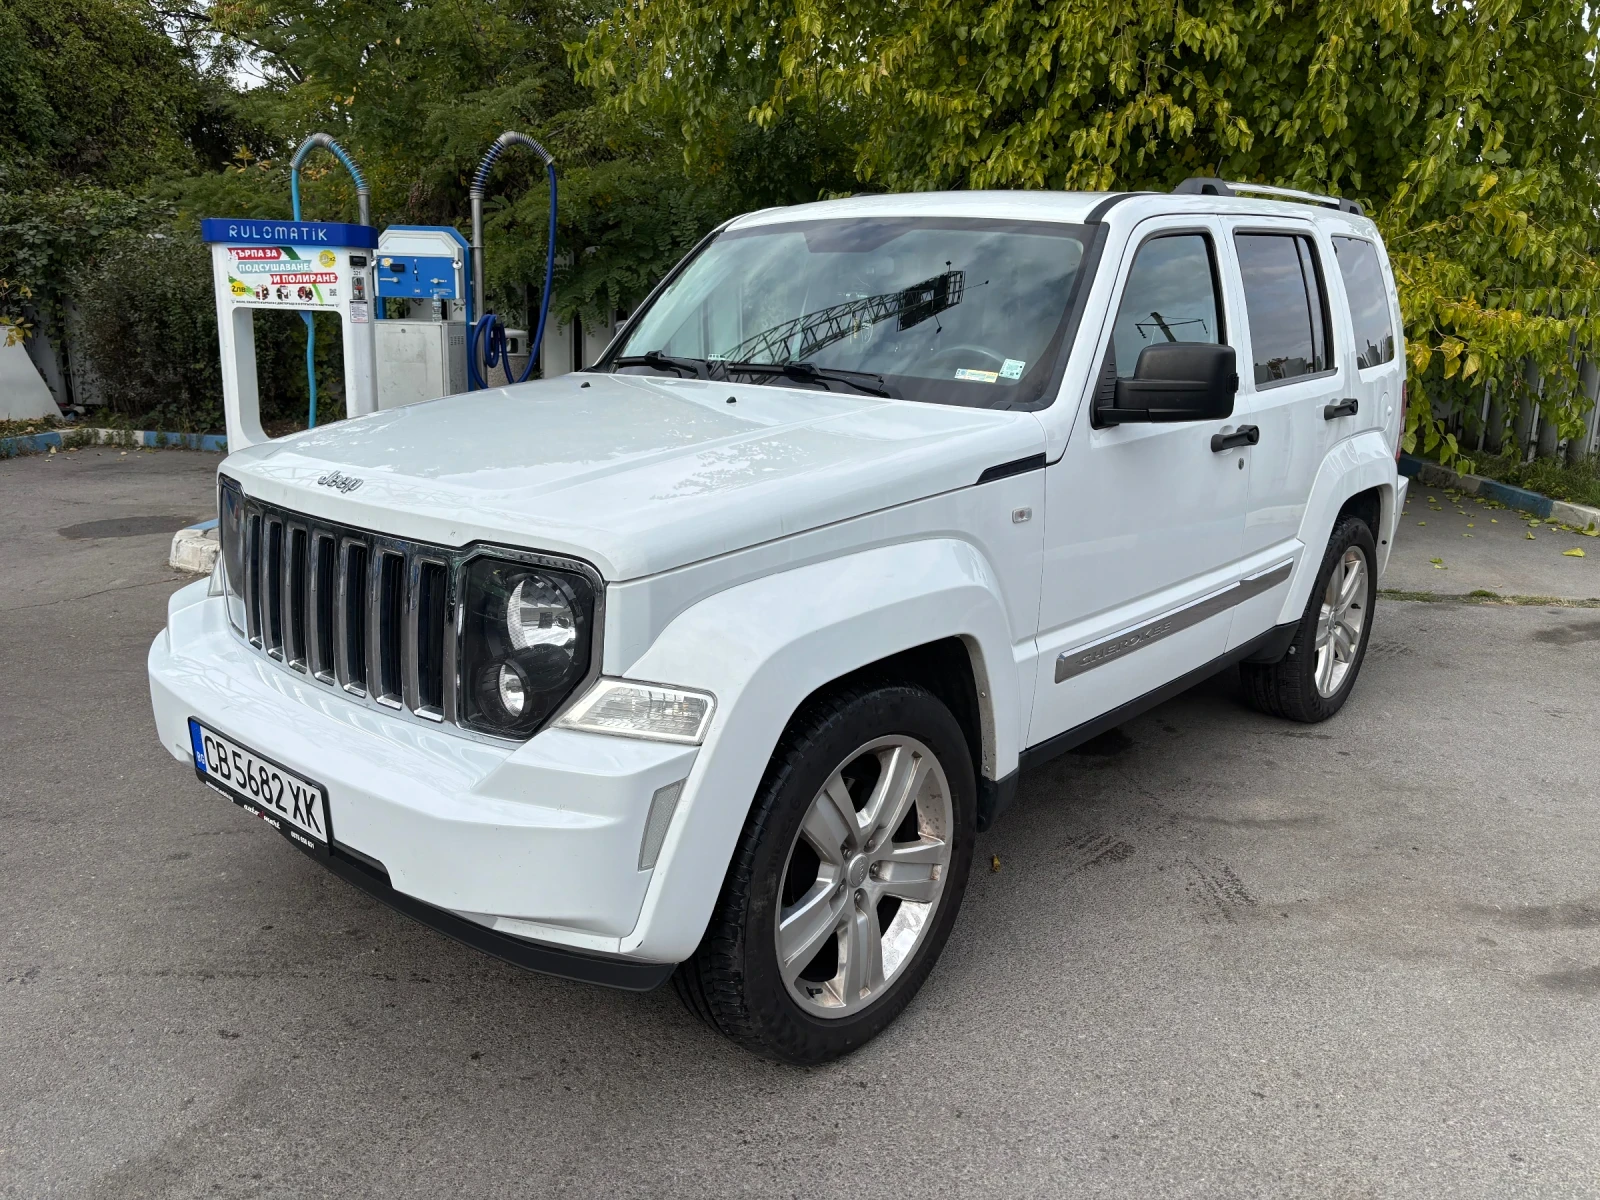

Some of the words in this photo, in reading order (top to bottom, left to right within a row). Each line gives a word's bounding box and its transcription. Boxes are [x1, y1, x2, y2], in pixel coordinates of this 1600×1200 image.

[230, 249, 264, 258] КЪРПА
[265, 249, 278, 257] ЗА
[238, 262, 310, 273] ПОДСУШАВАНЕ
[273, 275, 280, 283] И
[282, 274, 336, 283] ПОЛИРАНЕ
[317, 470, 364, 494] Jeep
[1078, 621, 1172, 667] CHEROKEE
